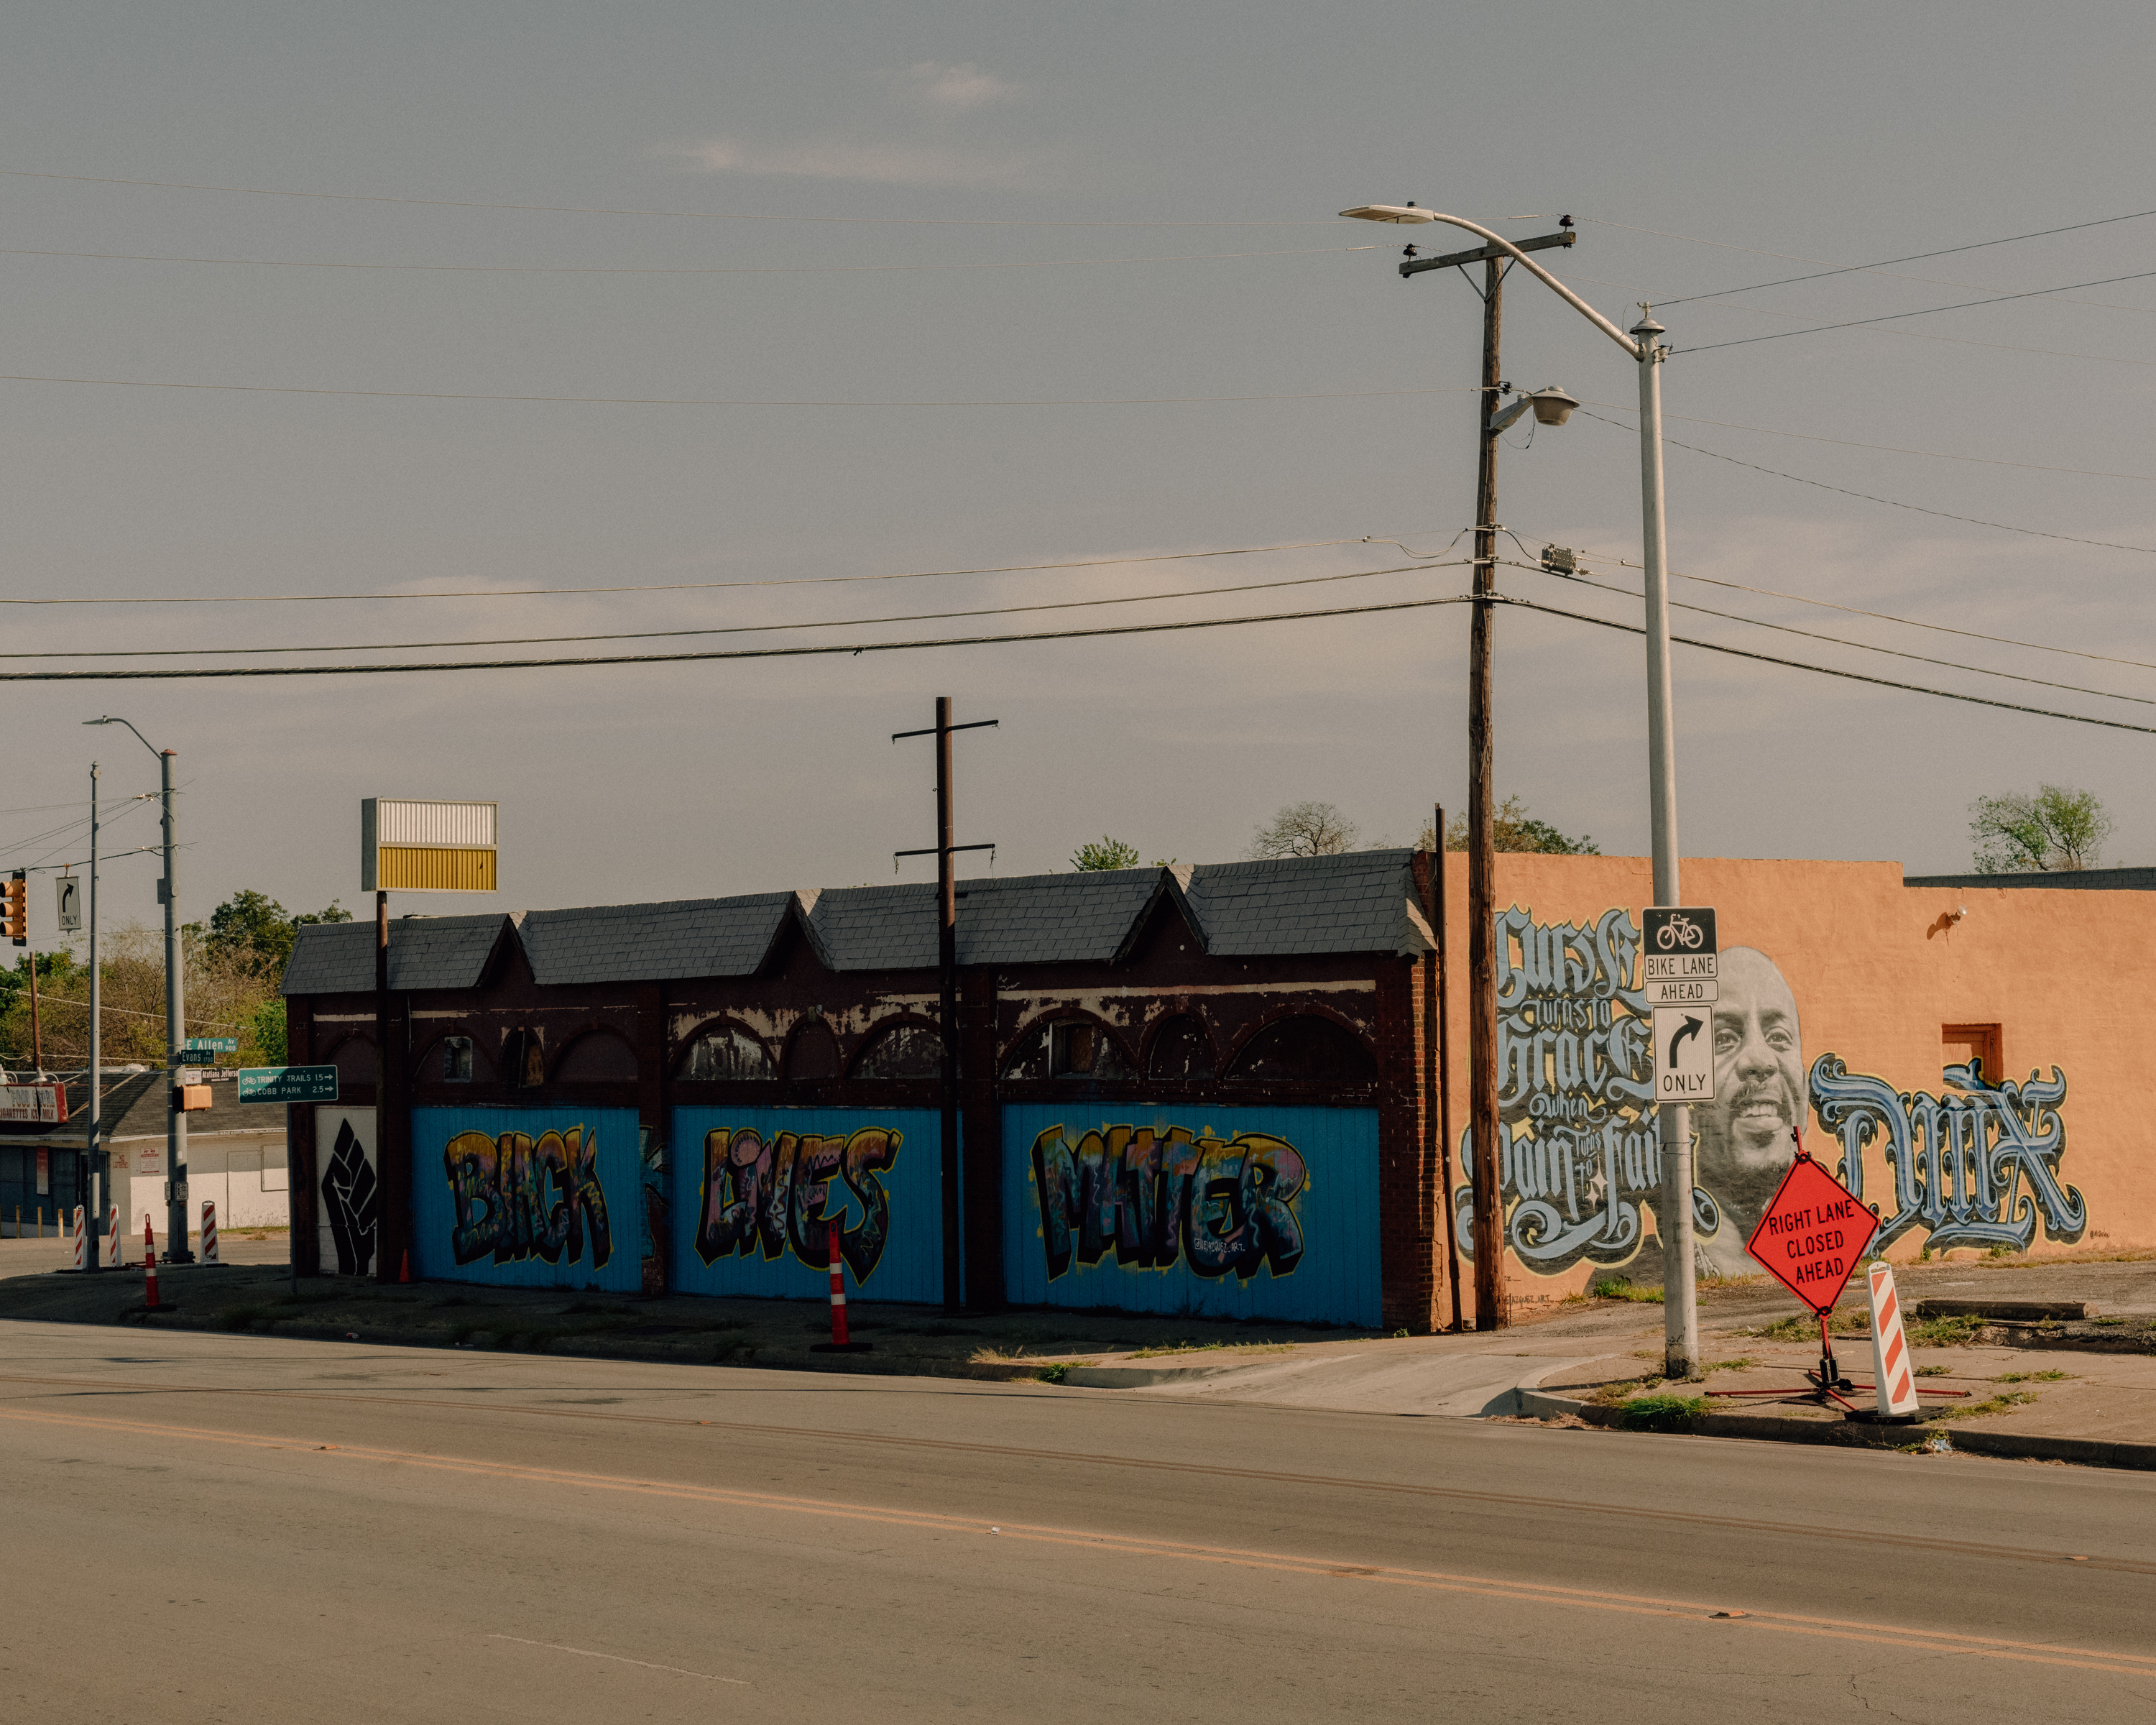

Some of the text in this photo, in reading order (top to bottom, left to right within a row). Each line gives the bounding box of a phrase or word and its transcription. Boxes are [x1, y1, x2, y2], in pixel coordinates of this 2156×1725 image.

[61, 915, 78, 926] ONLY
[1647, 957, 1714, 975] BIKE LANE
[1661, 983, 1703, 1000] AHEAD
[186, 1039, 193, 1050] E
[197, 1039, 224, 1050] Allen
[182, 1051, 201, 1062] Evans
[221, 1069, 238, 1077] Jefferso
[257, 1075, 282, 1084] TRINITY
[287, 1074, 311, 1082] TRAILS
[257, 1087, 277, 1095] COBB
[1663, 1074, 1706, 1092] ONLY
[11, 1089, 30, 1108] FOOD
[42, 1108, 54, 1120] MILK
[1029, 1123, 1307, 1283] MATTER
[1769, 1199, 1855, 1236] RIGHT LANE
[1787, 1230, 1845, 1259] CLOSED
[1795, 1257, 1844, 1285] AHEAD
